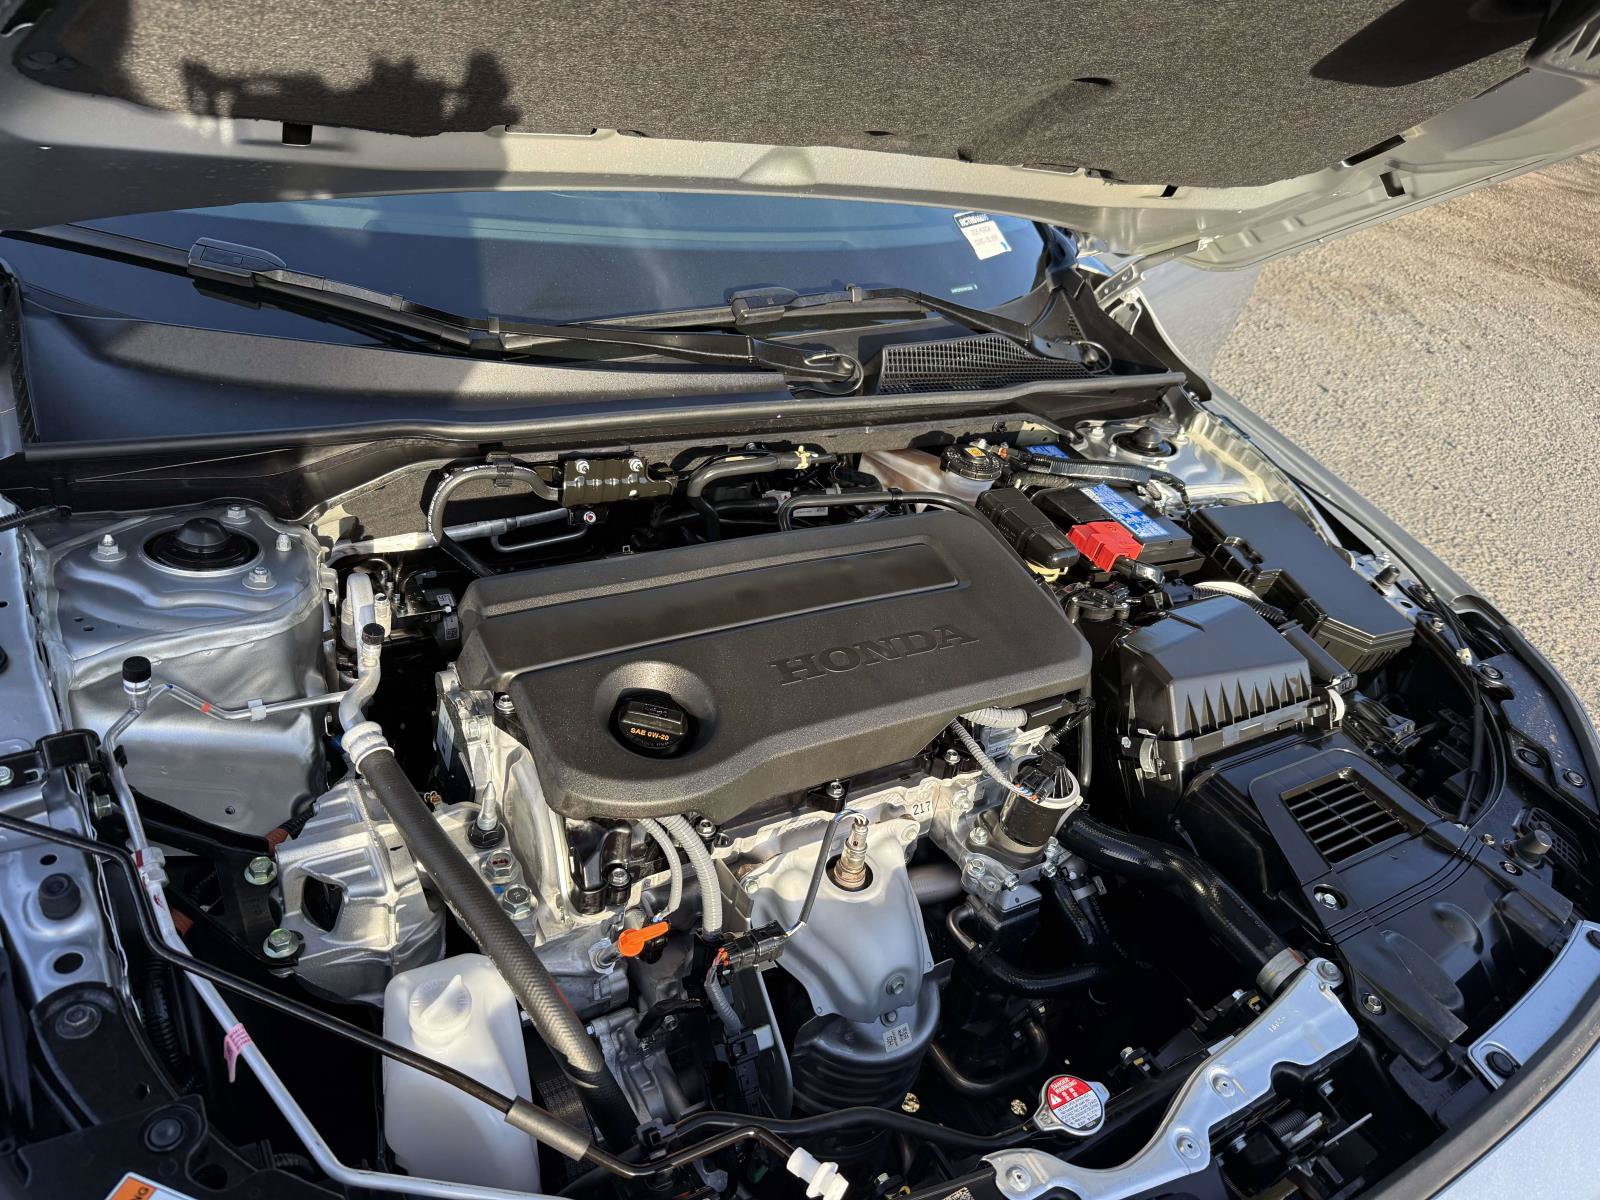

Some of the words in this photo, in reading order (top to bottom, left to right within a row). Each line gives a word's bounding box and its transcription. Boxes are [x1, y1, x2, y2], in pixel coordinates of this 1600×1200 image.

[769, 624, 980, 686] HONDA
[630, 728, 645, 736] SAE
[647, 731, 669, 740] 0W-20
[912, 800, 931, 816] 217
